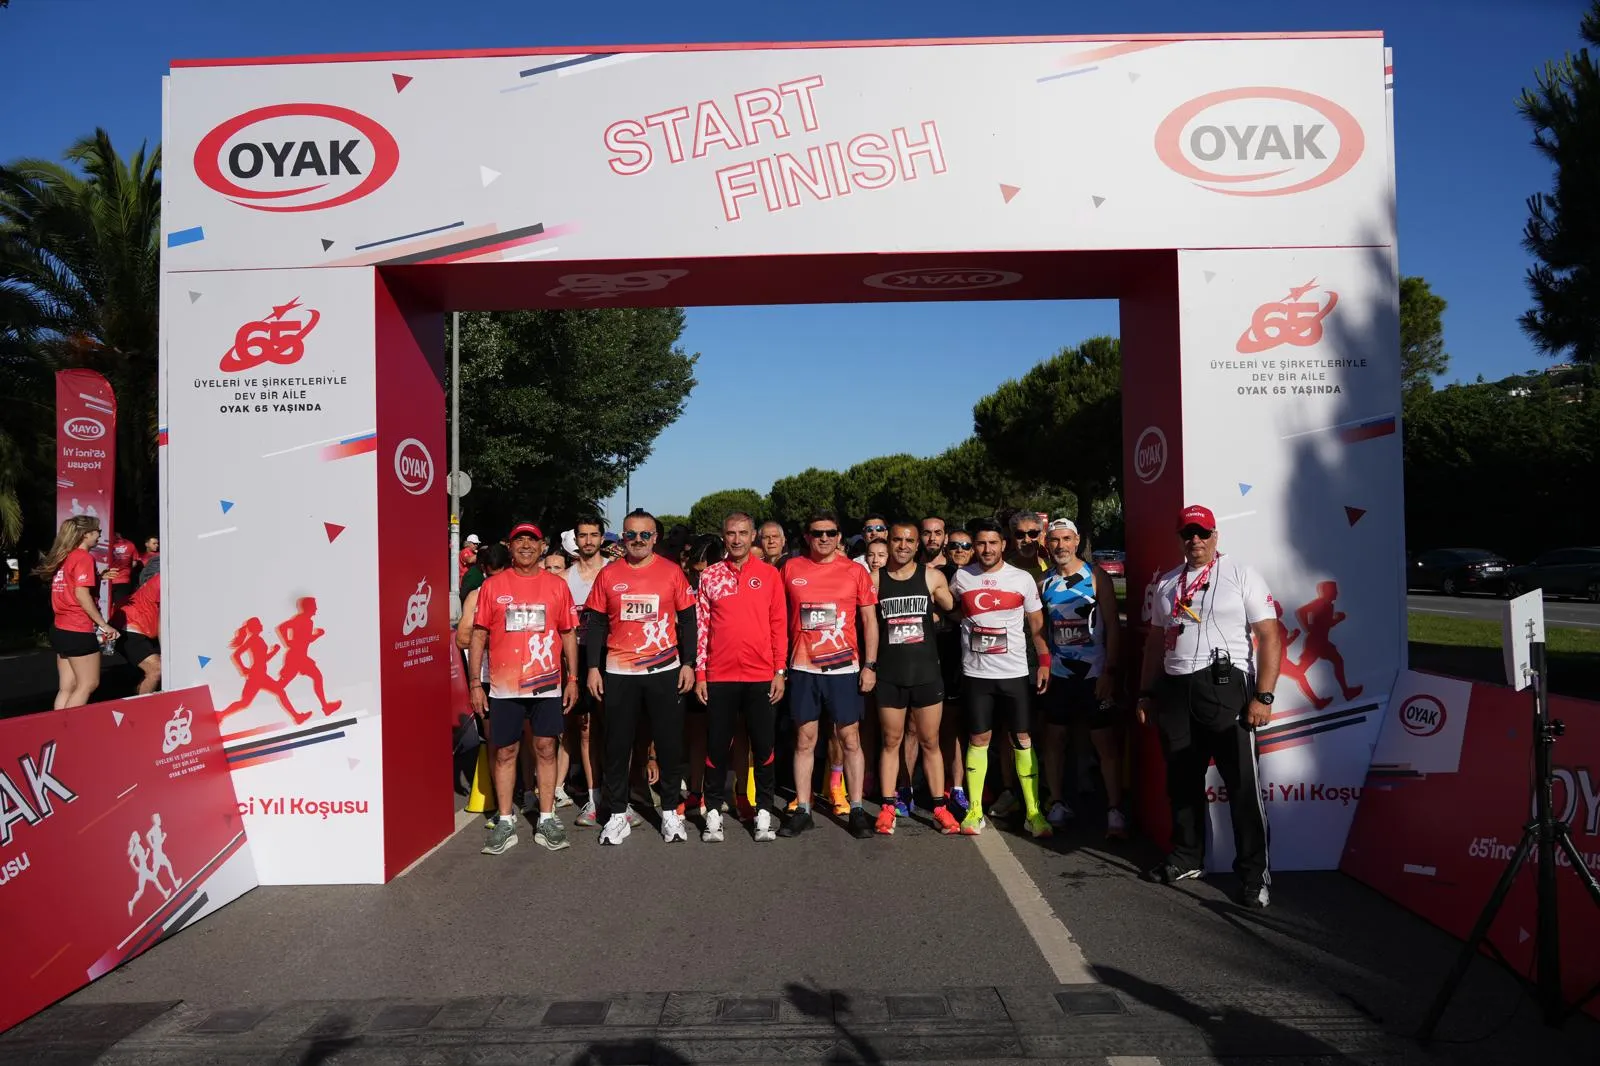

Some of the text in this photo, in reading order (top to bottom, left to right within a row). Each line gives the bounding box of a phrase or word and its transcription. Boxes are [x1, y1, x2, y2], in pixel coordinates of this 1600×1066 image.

[603, 75, 824, 175] START
[1190, 124, 1327, 162] OYAK
[228, 139, 362, 179] OYAK
[715, 120, 947, 222] FINISH
[894, 274, 997, 285] OYAK
[1251, 302, 1323, 347] 65
[235, 320, 305, 365] 65
[1210, 358, 1367, 371] ÜYELERİ VE ŞİRKETLERİYLE
[194, 376, 347, 389] ÜYELERİ VE ŞİRKETLERİYLE
[1252, 371, 1326, 382] DEV BİR AİLE
[234, 389, 307, 400] DEV BİR AİLE
[1237, 384, 1341, 396] OYAK 65 YAŞINDA
[220, 403, 322, 414] OYAK 65 YAŞINDA
[1138, 443, 1162, 463] OYAK
[401, 455, 427, 480] OYAK
[514, 611, 537, 624] 512
[626, 602, 653, 614] 2110
[810, 611, 826, 623] 65
[893, 625, 918, 637] 452
[981, 635, 997, 647] 57
[1060, 627, 1082, 639] 104
[1406, 705, 1439, 726] OYAK
[0, 738, 79, 847] AK
[1278, 783, 1305, 801] Yıl
[1310, 784, 1361, 806] Koşu
[1531, 767, 1600, 836] OY
[259, 798, 284, 815] Yıl
[290, 797, 368, 820] Koşusu
[1468, 836, 1516, 861] 65'inc
[0, 851, 31, 886] usu
